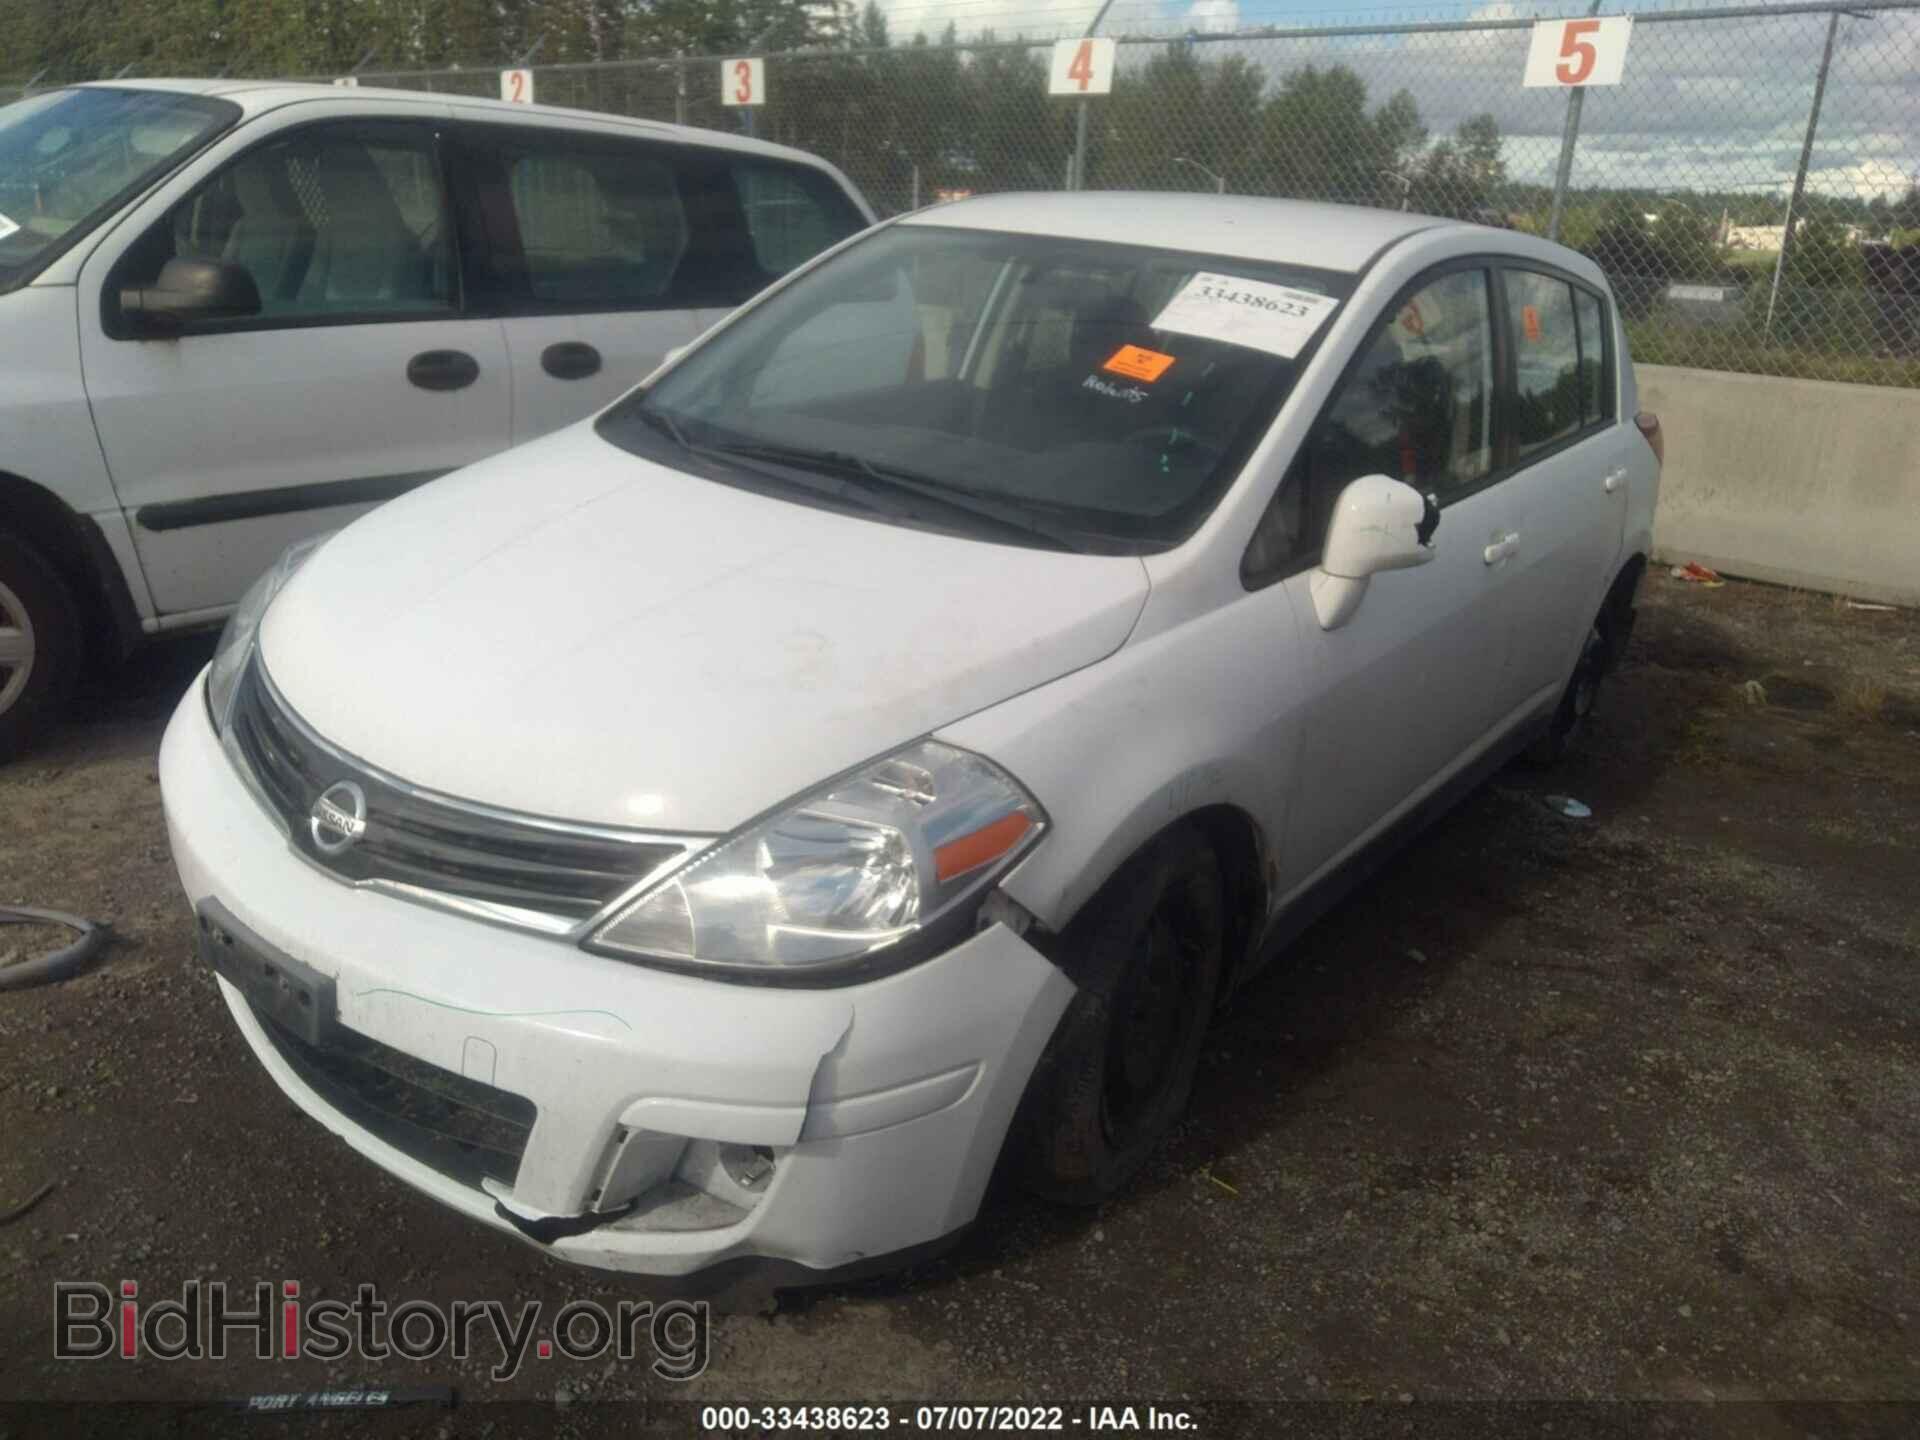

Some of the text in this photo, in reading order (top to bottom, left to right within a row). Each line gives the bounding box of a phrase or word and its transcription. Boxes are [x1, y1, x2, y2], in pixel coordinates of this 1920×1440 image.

[1067, 40, 1094, 91] 4
[1555, 19, 1601, 84] 5
[511, 72, 524, 104] 2
[735, 61, 751, 103] 3
[1196, 286, 1310, 317] 33438623
[319, 806, 355, 833] SSAN
